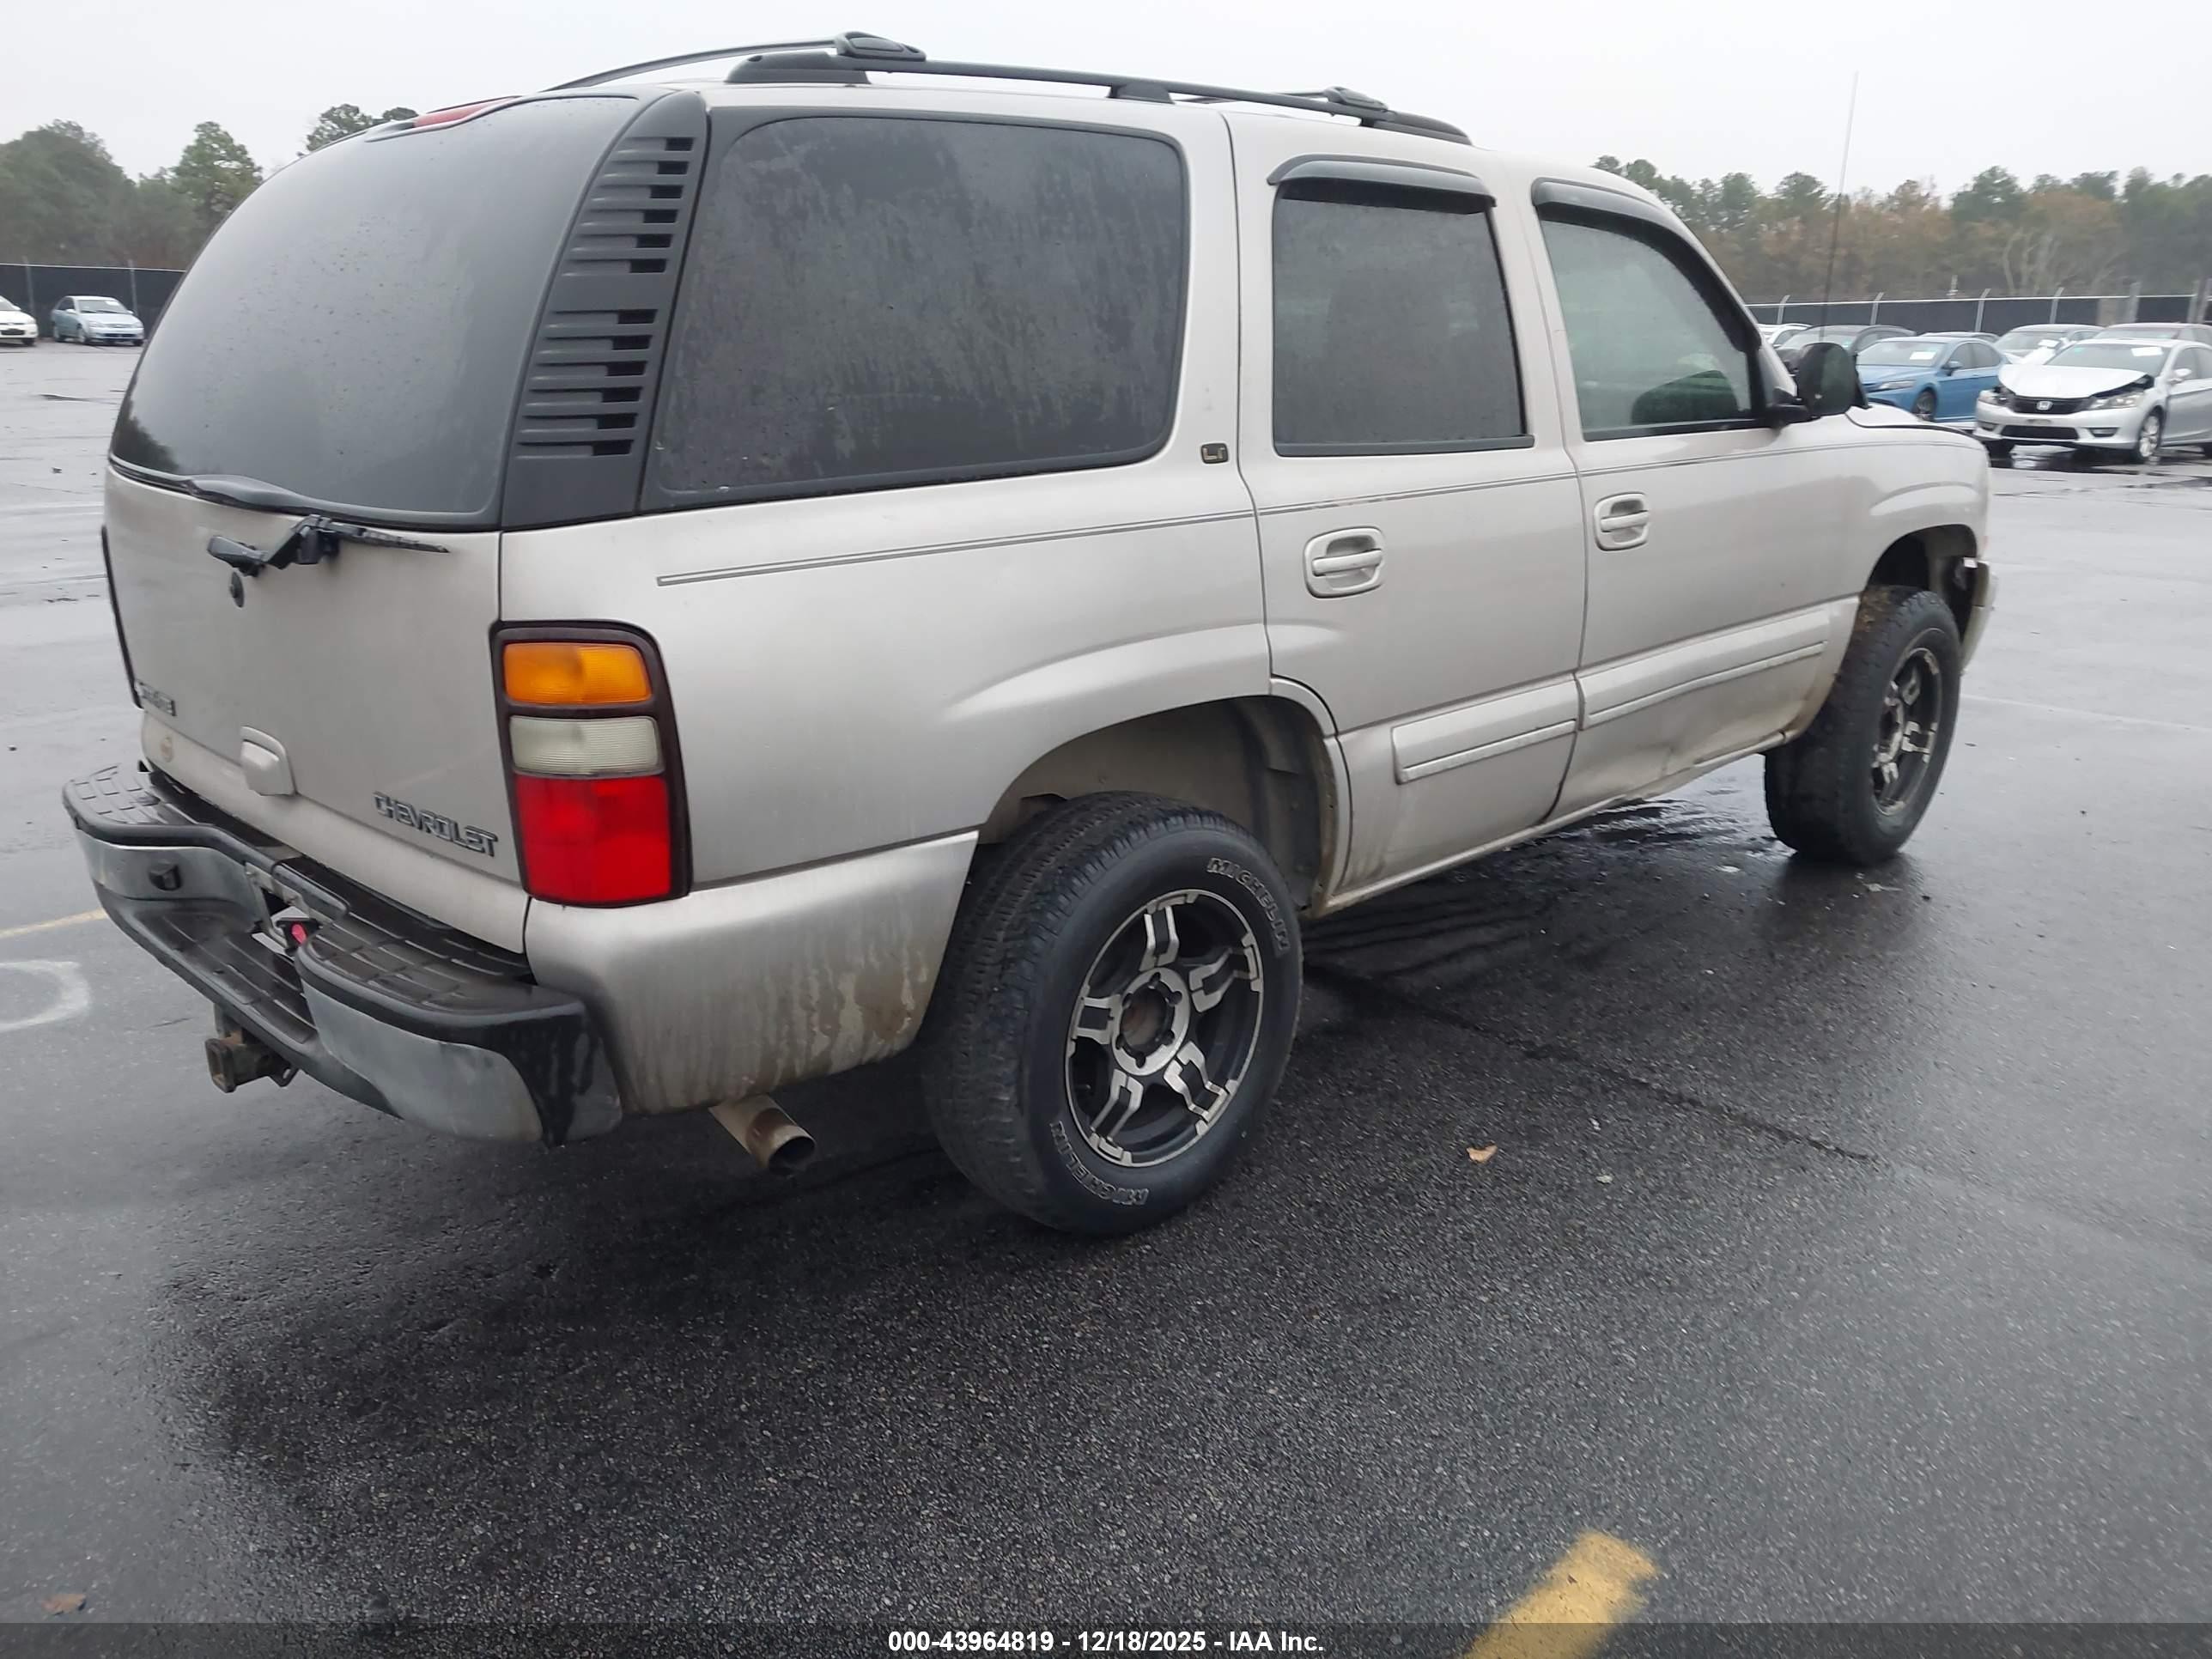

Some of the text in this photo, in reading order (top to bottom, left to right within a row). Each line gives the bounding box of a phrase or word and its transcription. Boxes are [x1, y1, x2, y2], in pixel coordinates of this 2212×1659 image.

[372, 790, 498, 858] CHEVROLET
[1206, 858, 1290, 958] MICHELIN
[1049, 1120, 1149, 1206] MICHELIN
